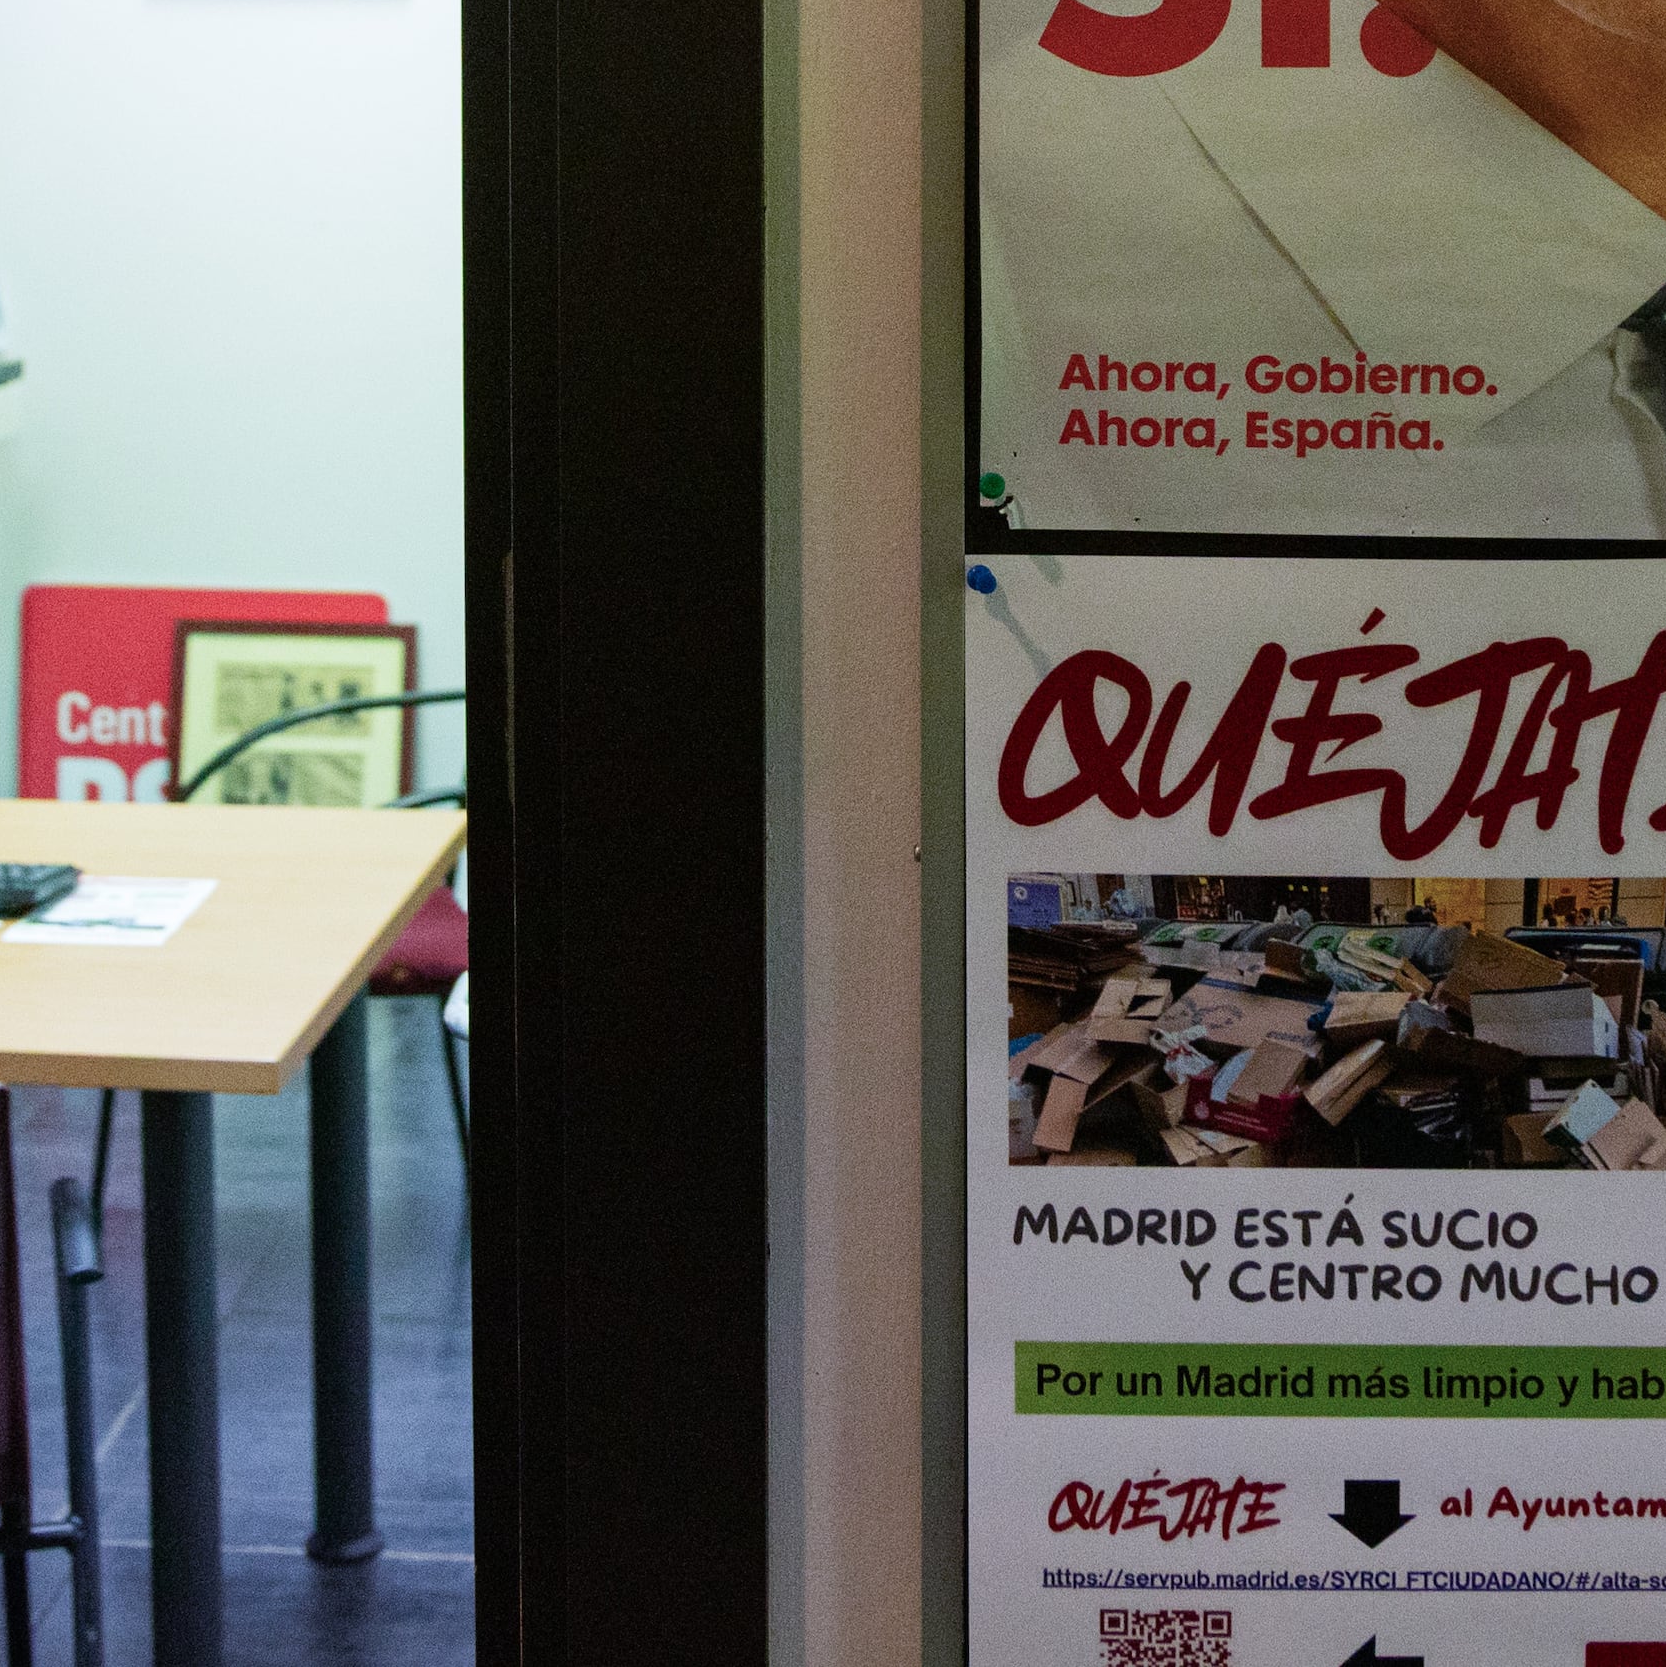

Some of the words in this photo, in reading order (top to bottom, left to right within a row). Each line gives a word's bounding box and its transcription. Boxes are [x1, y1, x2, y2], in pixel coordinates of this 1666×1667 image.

[1060, 353, 1229, 399] Ahora,
[1244, 355, 1498, 396] Gobierno.
[1059, 409, 1229, 455] Ahora,
[1245, 411, 1444, 458] España.
[57, 690, 168, 746] Cent
[1013, 1203, 1216, 1247] MADRID
[1234, 1194, 1364, 1249] ESTÁ
[1382, 1209, 1538, 1251] SUCIO
[1180, 1260, 1211, 1301] Y
[1229, 1260, 1442, 1303] CENTRO
[1460, 1261, 1659, 1305] MUCHO
[1036, 1363, 1103, 1396] Por
[1116, 1372, 1162, 1397] un
[1177, 1365, 1314, 1398] Madrid
[1328, 1366, 1410, 1398] más
[1423, 1367, 1545, 1407] limpio
[1557, 1376, 1579, 1407] y
[1048, 1471, 1286, 1542] QUÉJATE
[1440, 1488, 1473, 1517] al
